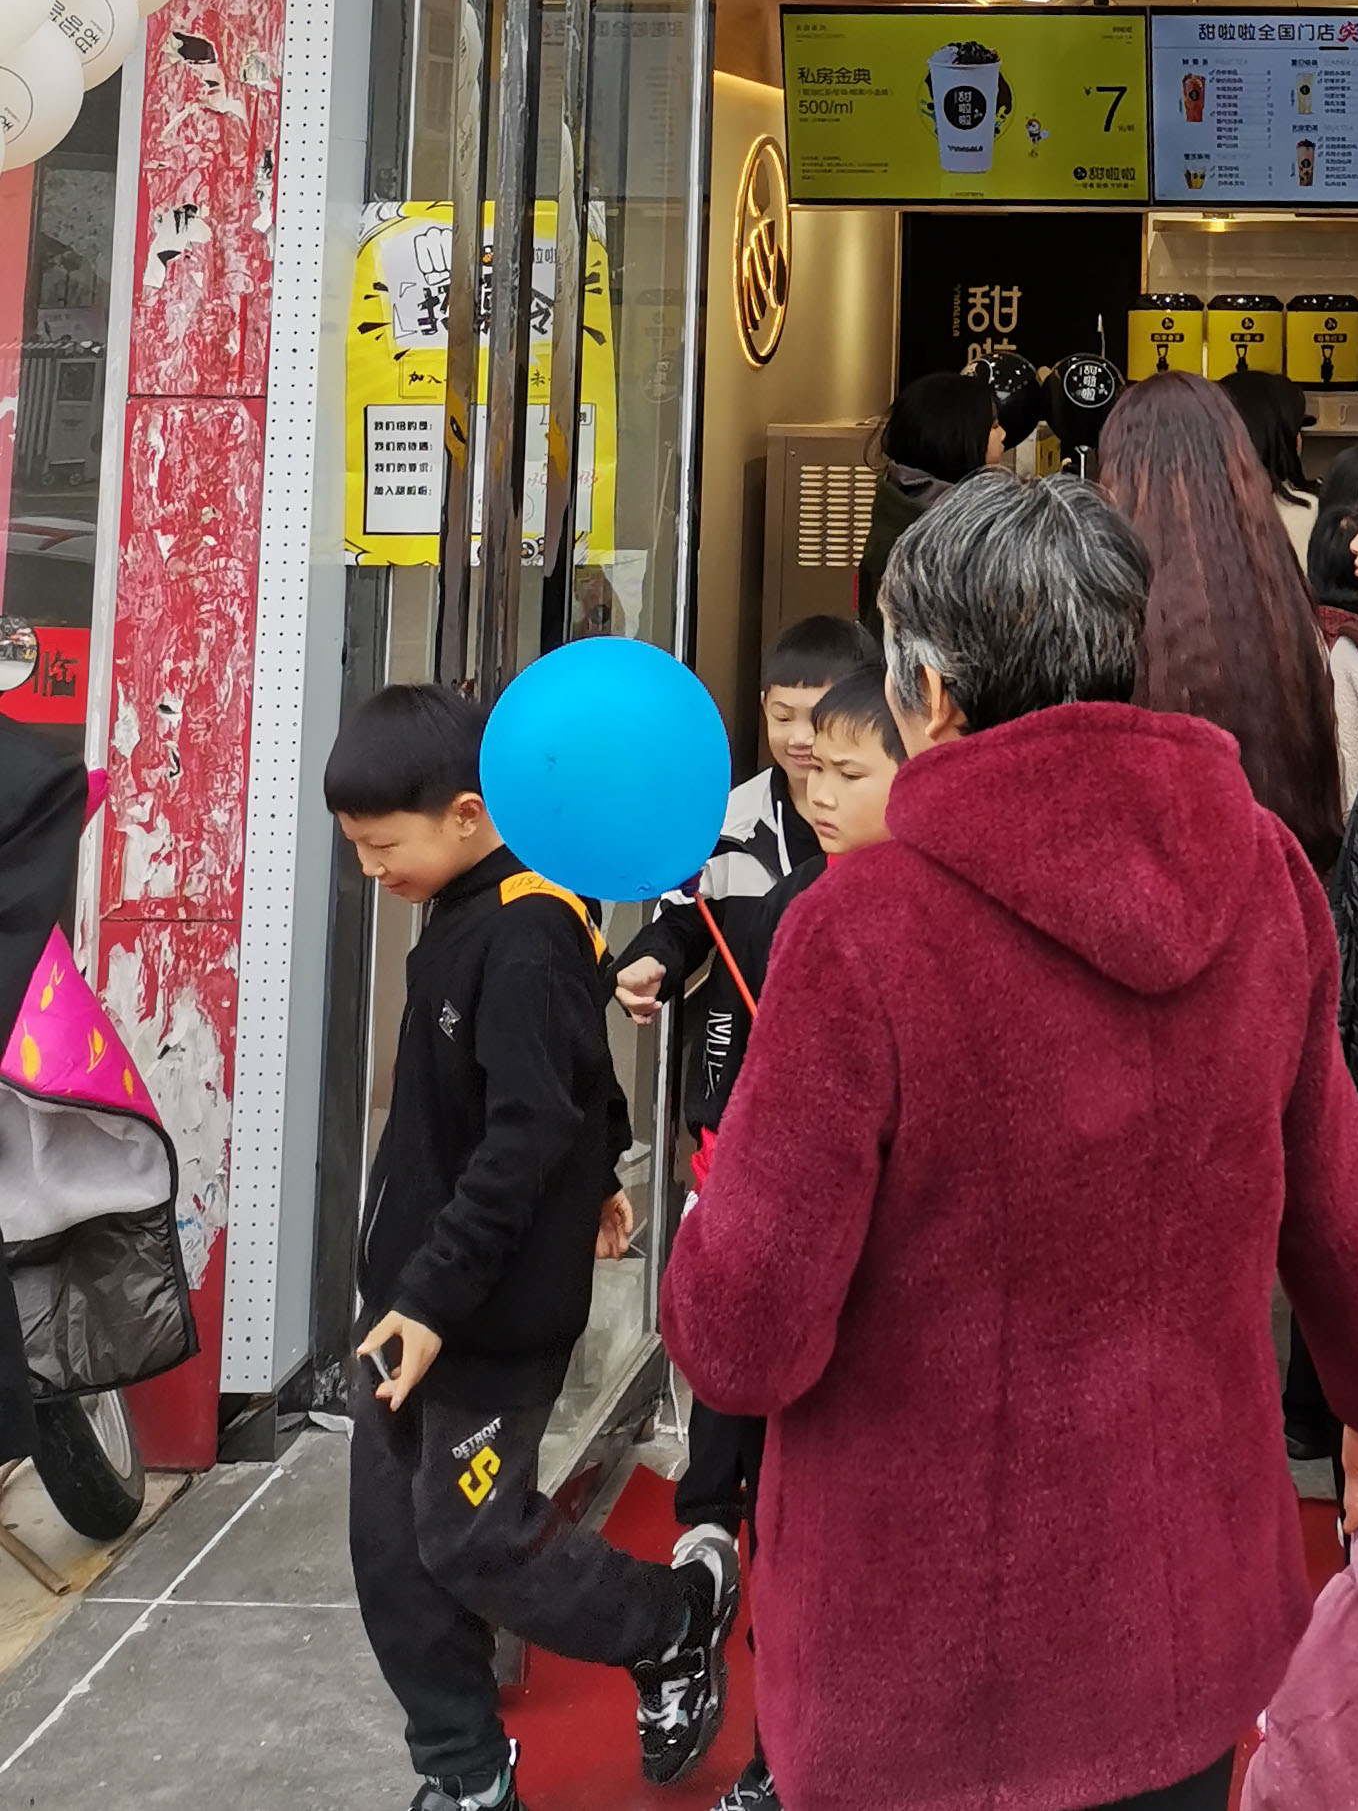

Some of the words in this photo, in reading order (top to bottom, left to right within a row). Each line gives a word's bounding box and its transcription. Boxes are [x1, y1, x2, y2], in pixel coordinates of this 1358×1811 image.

[797, 66, 873, 86] 私房金典
[798, 99, 854, 116] 500/ml
